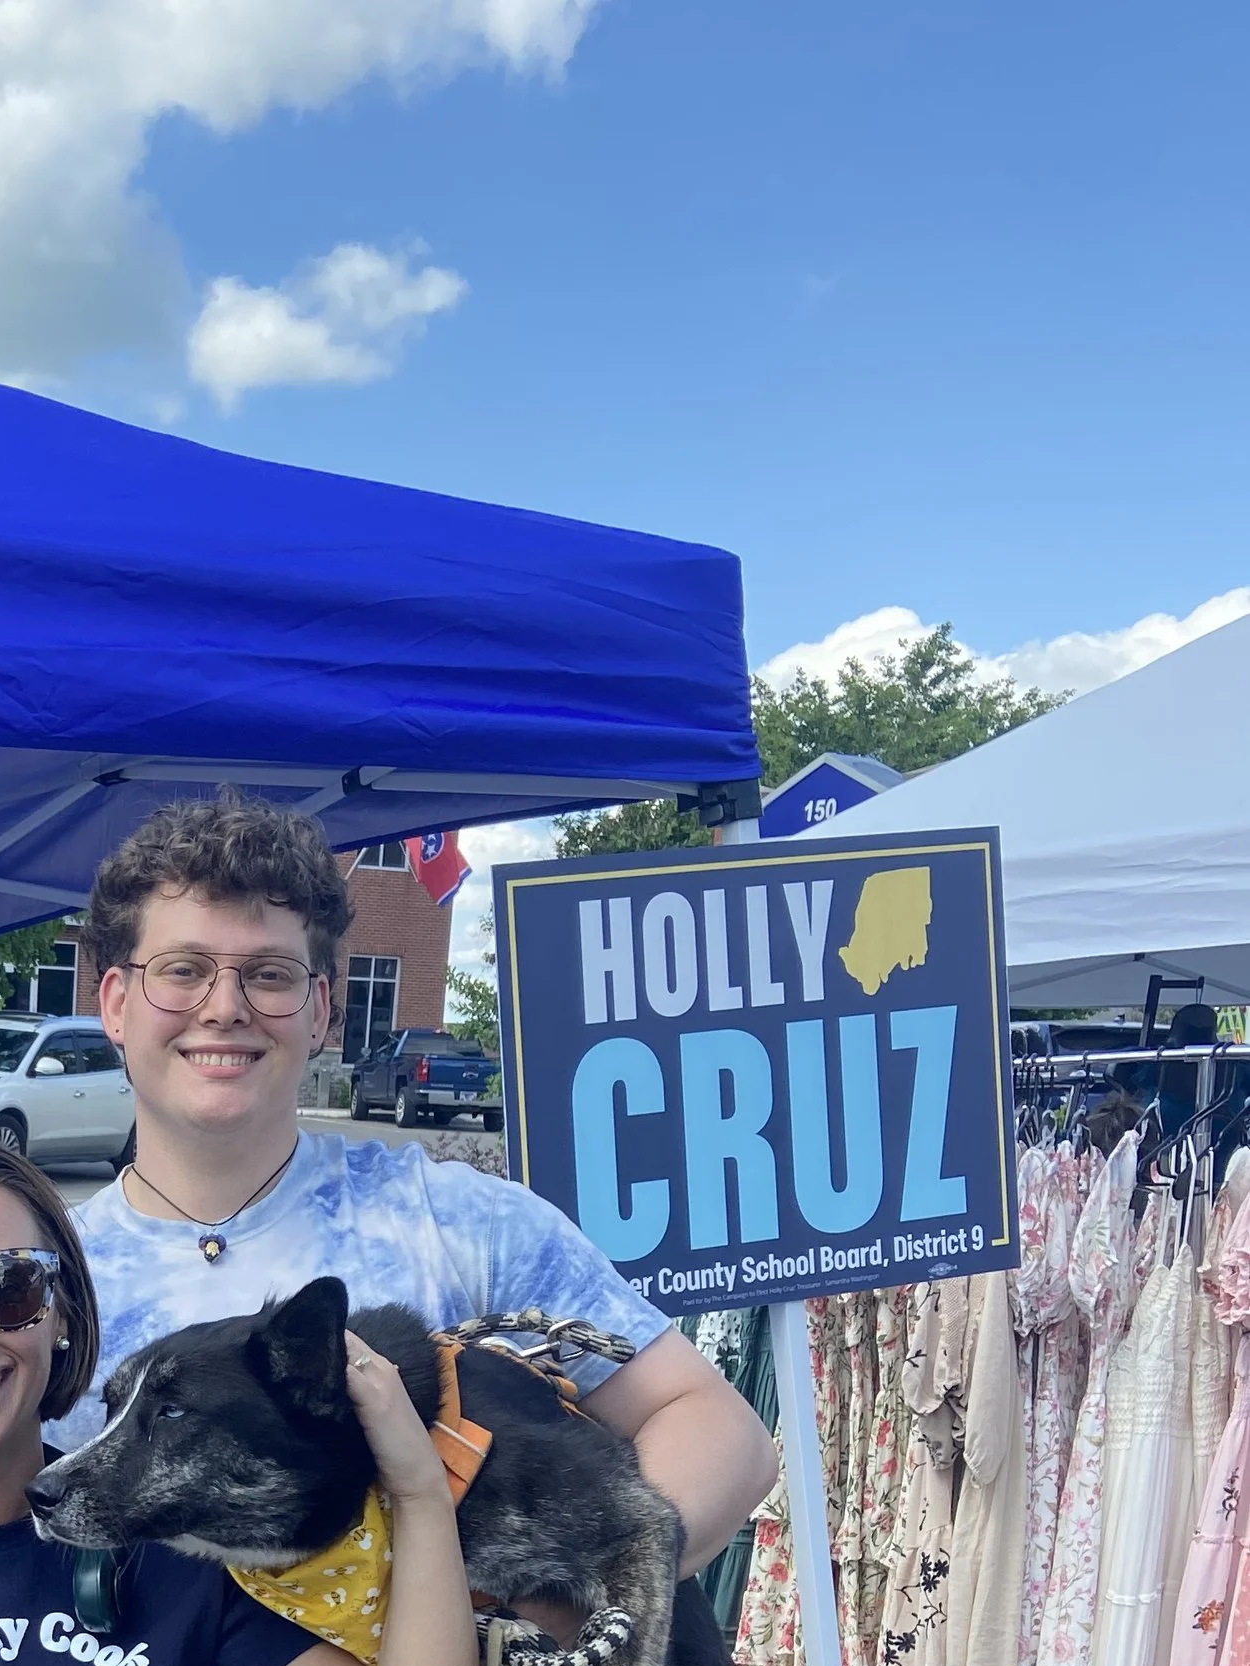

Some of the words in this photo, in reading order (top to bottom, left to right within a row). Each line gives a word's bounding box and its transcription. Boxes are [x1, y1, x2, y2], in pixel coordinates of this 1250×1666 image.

[804, 797, 837, 822] 150
[578, 879, 835, 1025] HOLLY
[571, 1004, 968, 1263] CRUZ
[658, 1260, 737, 1295] County
[741, 1247, 815, 1284] School
[820, 1238, 890, 1273] Board,
[893, 1230, 969, 1263] District
[971, 1224, 985, 1251] 9
